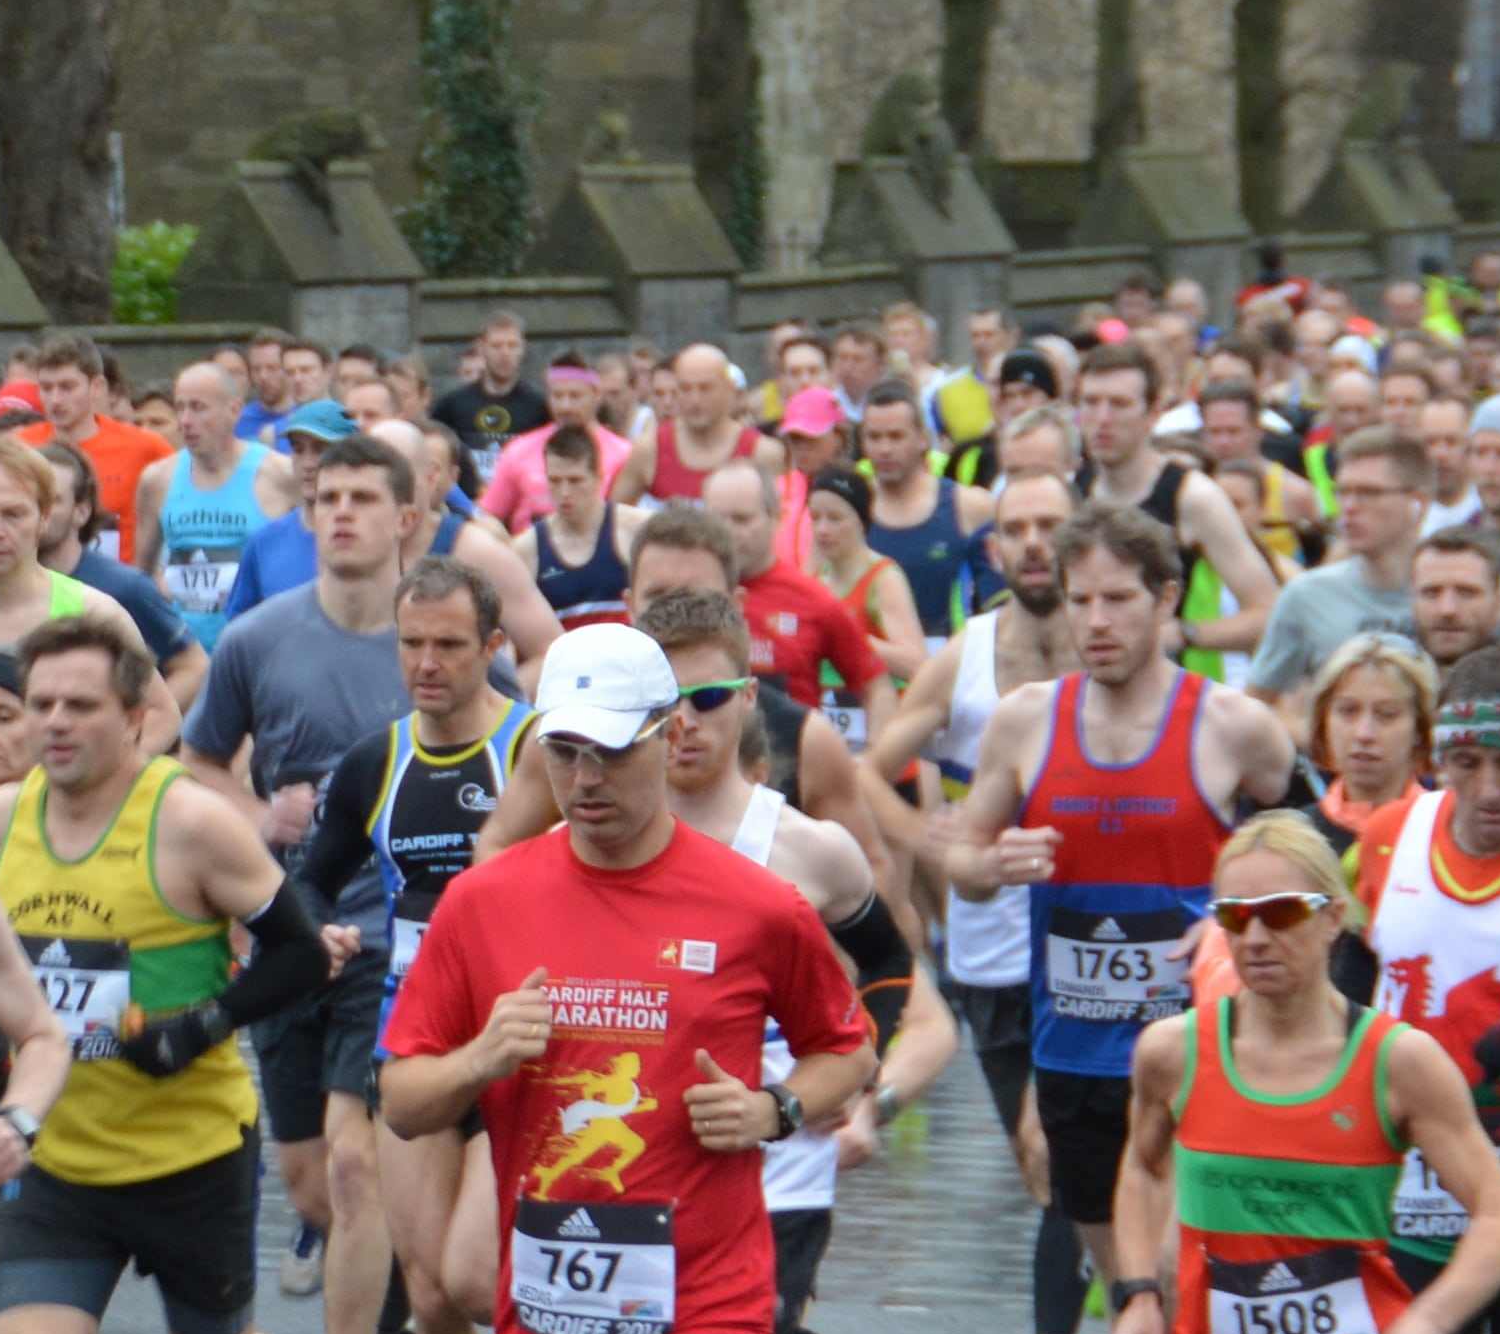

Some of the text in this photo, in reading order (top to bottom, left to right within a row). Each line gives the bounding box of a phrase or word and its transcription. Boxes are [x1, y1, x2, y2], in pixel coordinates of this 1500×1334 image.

[167, 511, 248, 529] Lothian
[181, 569, 220, 588] 1717
[390, 832, 465, 853] CARDIFF
[1071, 945, 1156, 982] 1763
[619, 989, 670, 1008] HALF
[1055, 995, 1139, 1021] CARDIFF
[551, 1003, 668, 1031] ARATHON
[539, 1246, 623, 1294] 767
